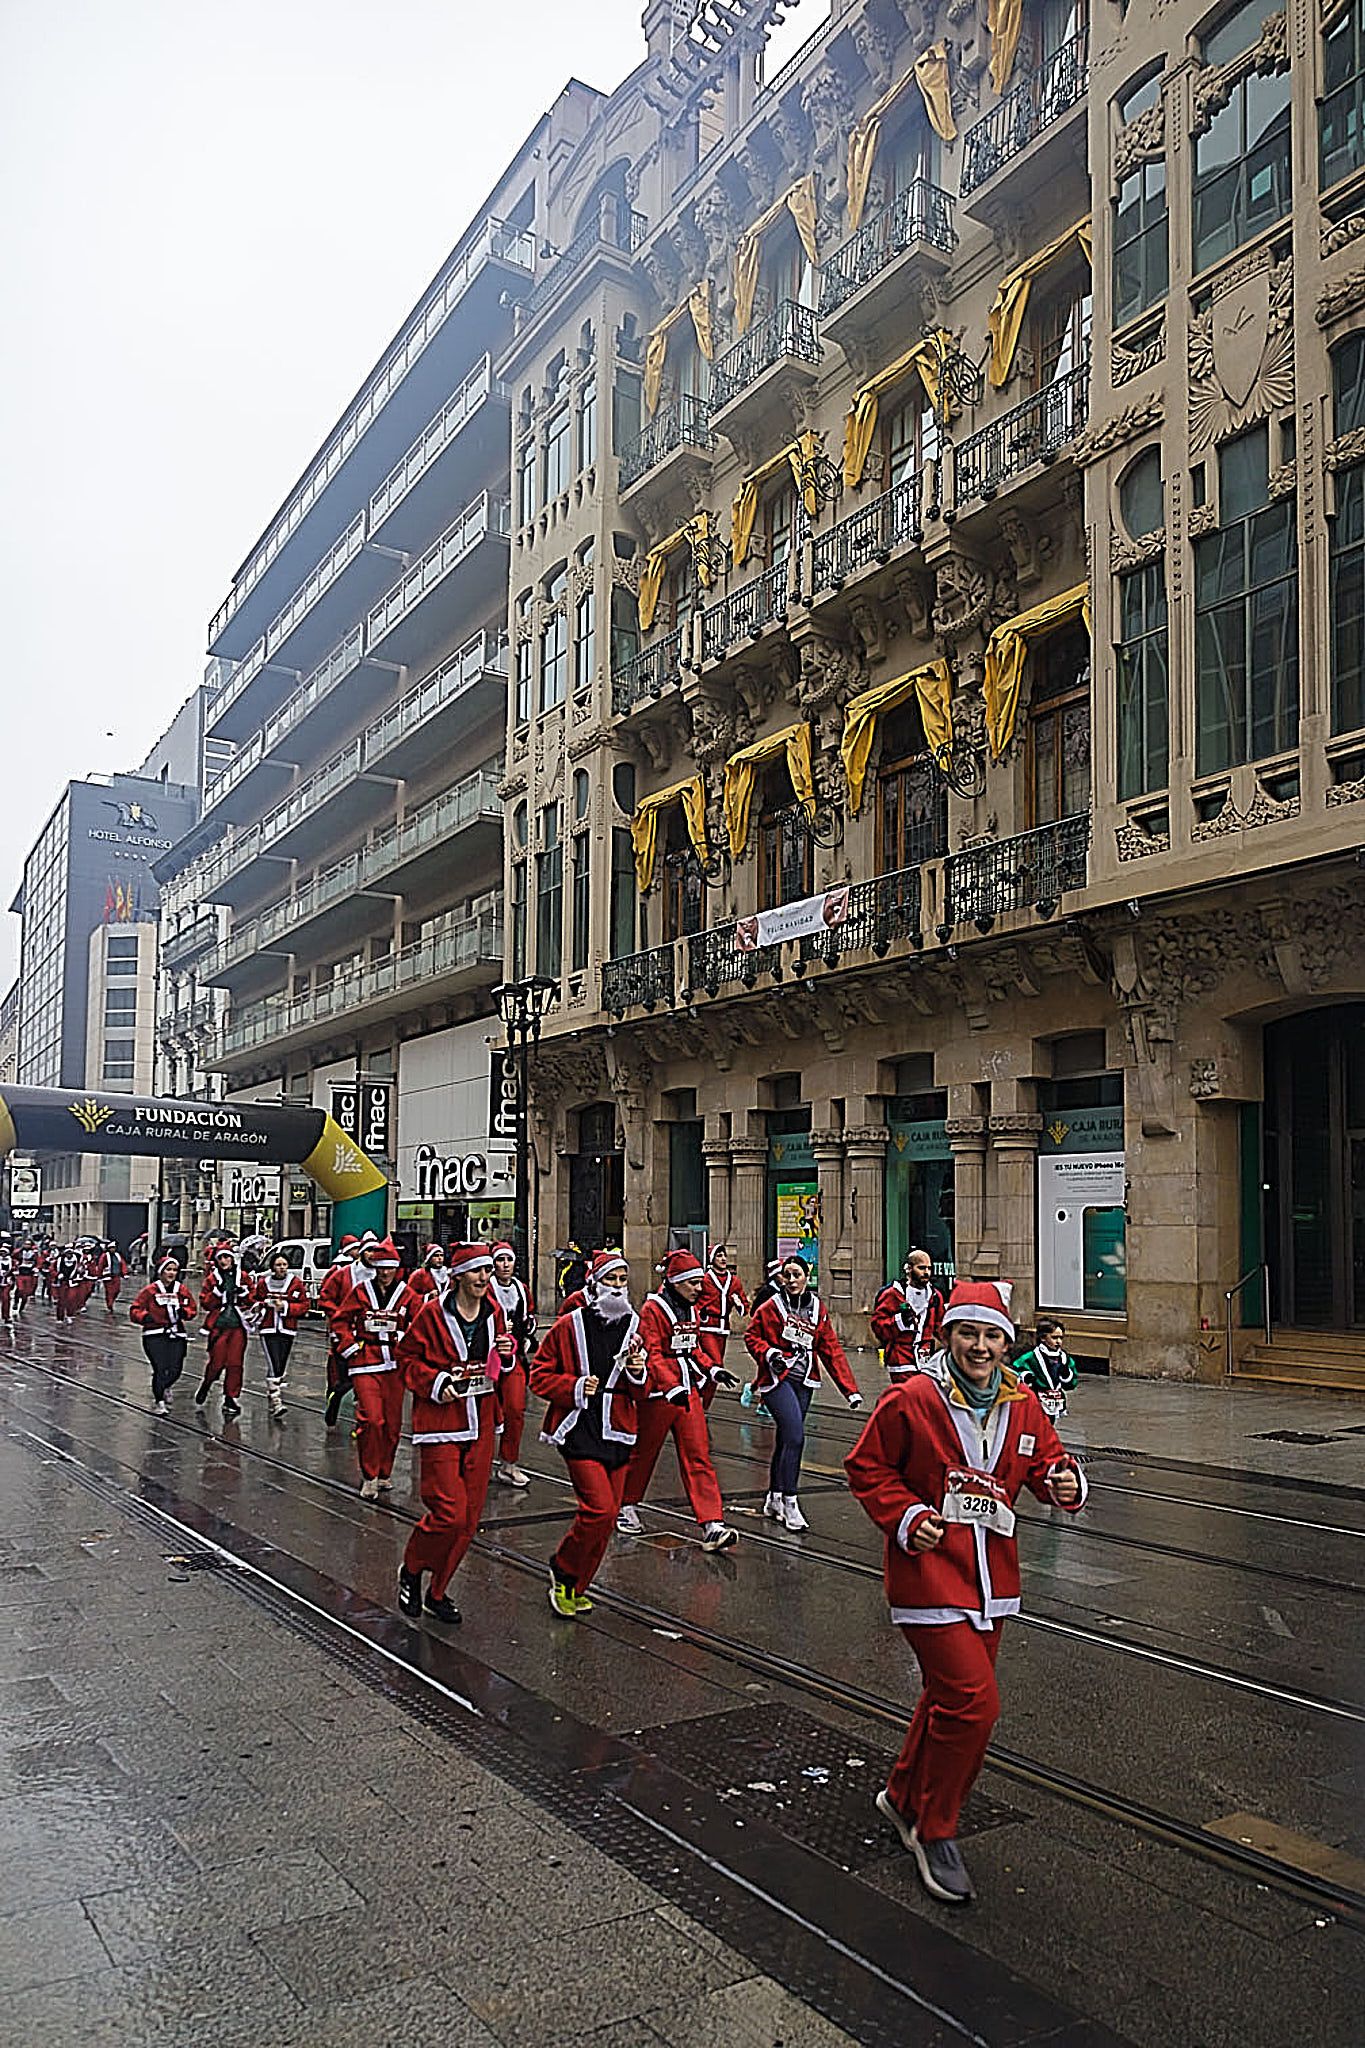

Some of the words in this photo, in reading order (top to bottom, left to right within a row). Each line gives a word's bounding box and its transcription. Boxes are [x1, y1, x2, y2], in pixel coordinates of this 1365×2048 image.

[88, 829, 122, 842] HOTEL
[126, 834, 173, 849] ALFONSO
[785, 914, 814, 929] NAVIDAD
[494, 1058, 517, 1135] fnac
[134, 1107, 242, 1128] FUNDACIÓN
[364, 1088, 386, 1151] fnac
[1072, 1120, 1097, 1132] CAJA
[106, 1124, 141, 1136] CAJA
[145, 1127, 189, 1140] RURAL
[193, 1131, 210, 1141] DE
[214, 1131, 268, 1144] ARAGÓN
[415, 1145, 483, 1199] fnac
[230, 1168, 262, 1203] fnac
[933, 1262, 943, 1275] TE
[962, 1496, 998, 1515] 3289
